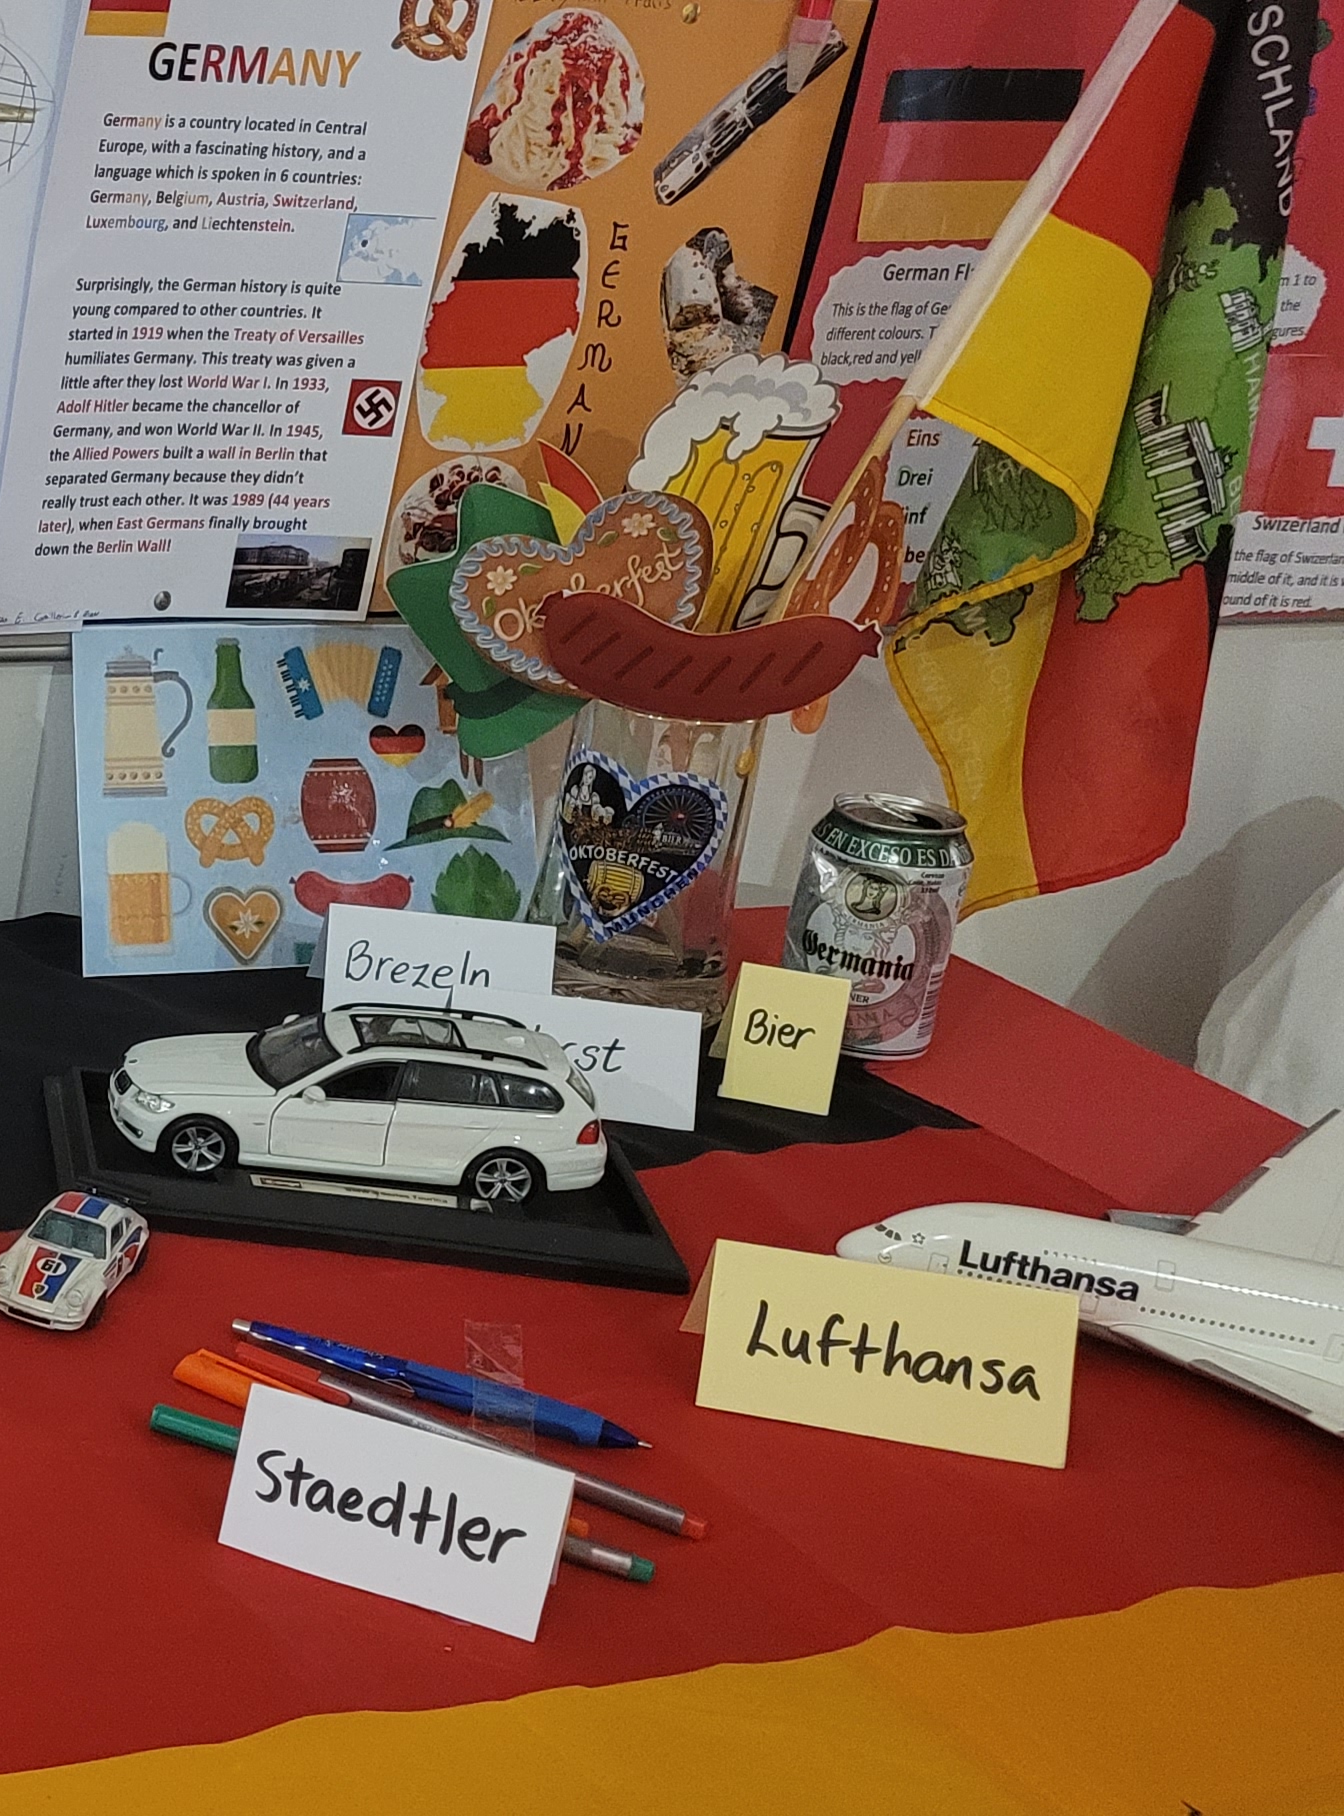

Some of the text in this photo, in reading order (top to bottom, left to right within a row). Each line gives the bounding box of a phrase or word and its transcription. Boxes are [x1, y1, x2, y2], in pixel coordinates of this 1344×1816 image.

[148, 41, 362, 89] GERMANY
[103, 112, 368, 136] Germany is a country located in Central
[98, 139, 366, 162] Europe, with a fascinating history, and a
[94, 163, 362, 186] language which is spoken in 6 countries:
[90, 189, 358, 212] Germany, Belgium, Austria, Switzerland,
[86, 214, 295, 233] Luxembourg, and Liechtenstein.
[883, 263, 950, 281] German
[832, 301, 930, 318] This is the flag of
[826, 325, 924, 341] different colours.
[875, 350, 897, 364] and
[906, 429, 941, 447] Eins
[898, 468, 933, 486] Drei
[1252, 515, 1342, 534] Swizerland
[1234, 549, 1295, 565] the flag of
[825, 826, 936, 867] EN EXCESO ES
[569, 845, 678, 883] OKTOBERFEST
[345, 939, 491, 989] Brezeln
[802, 928, 915, 981] Germania
[743, 1008, 816, 1051] Bier
[41, 1259, 62, 1274] 61
[959, 1239, 1140, 1303] Lufthansa
[746, 1299, 1041, 1402] Lufthansa
[254, 1449, 529, 1565] Staedtler
